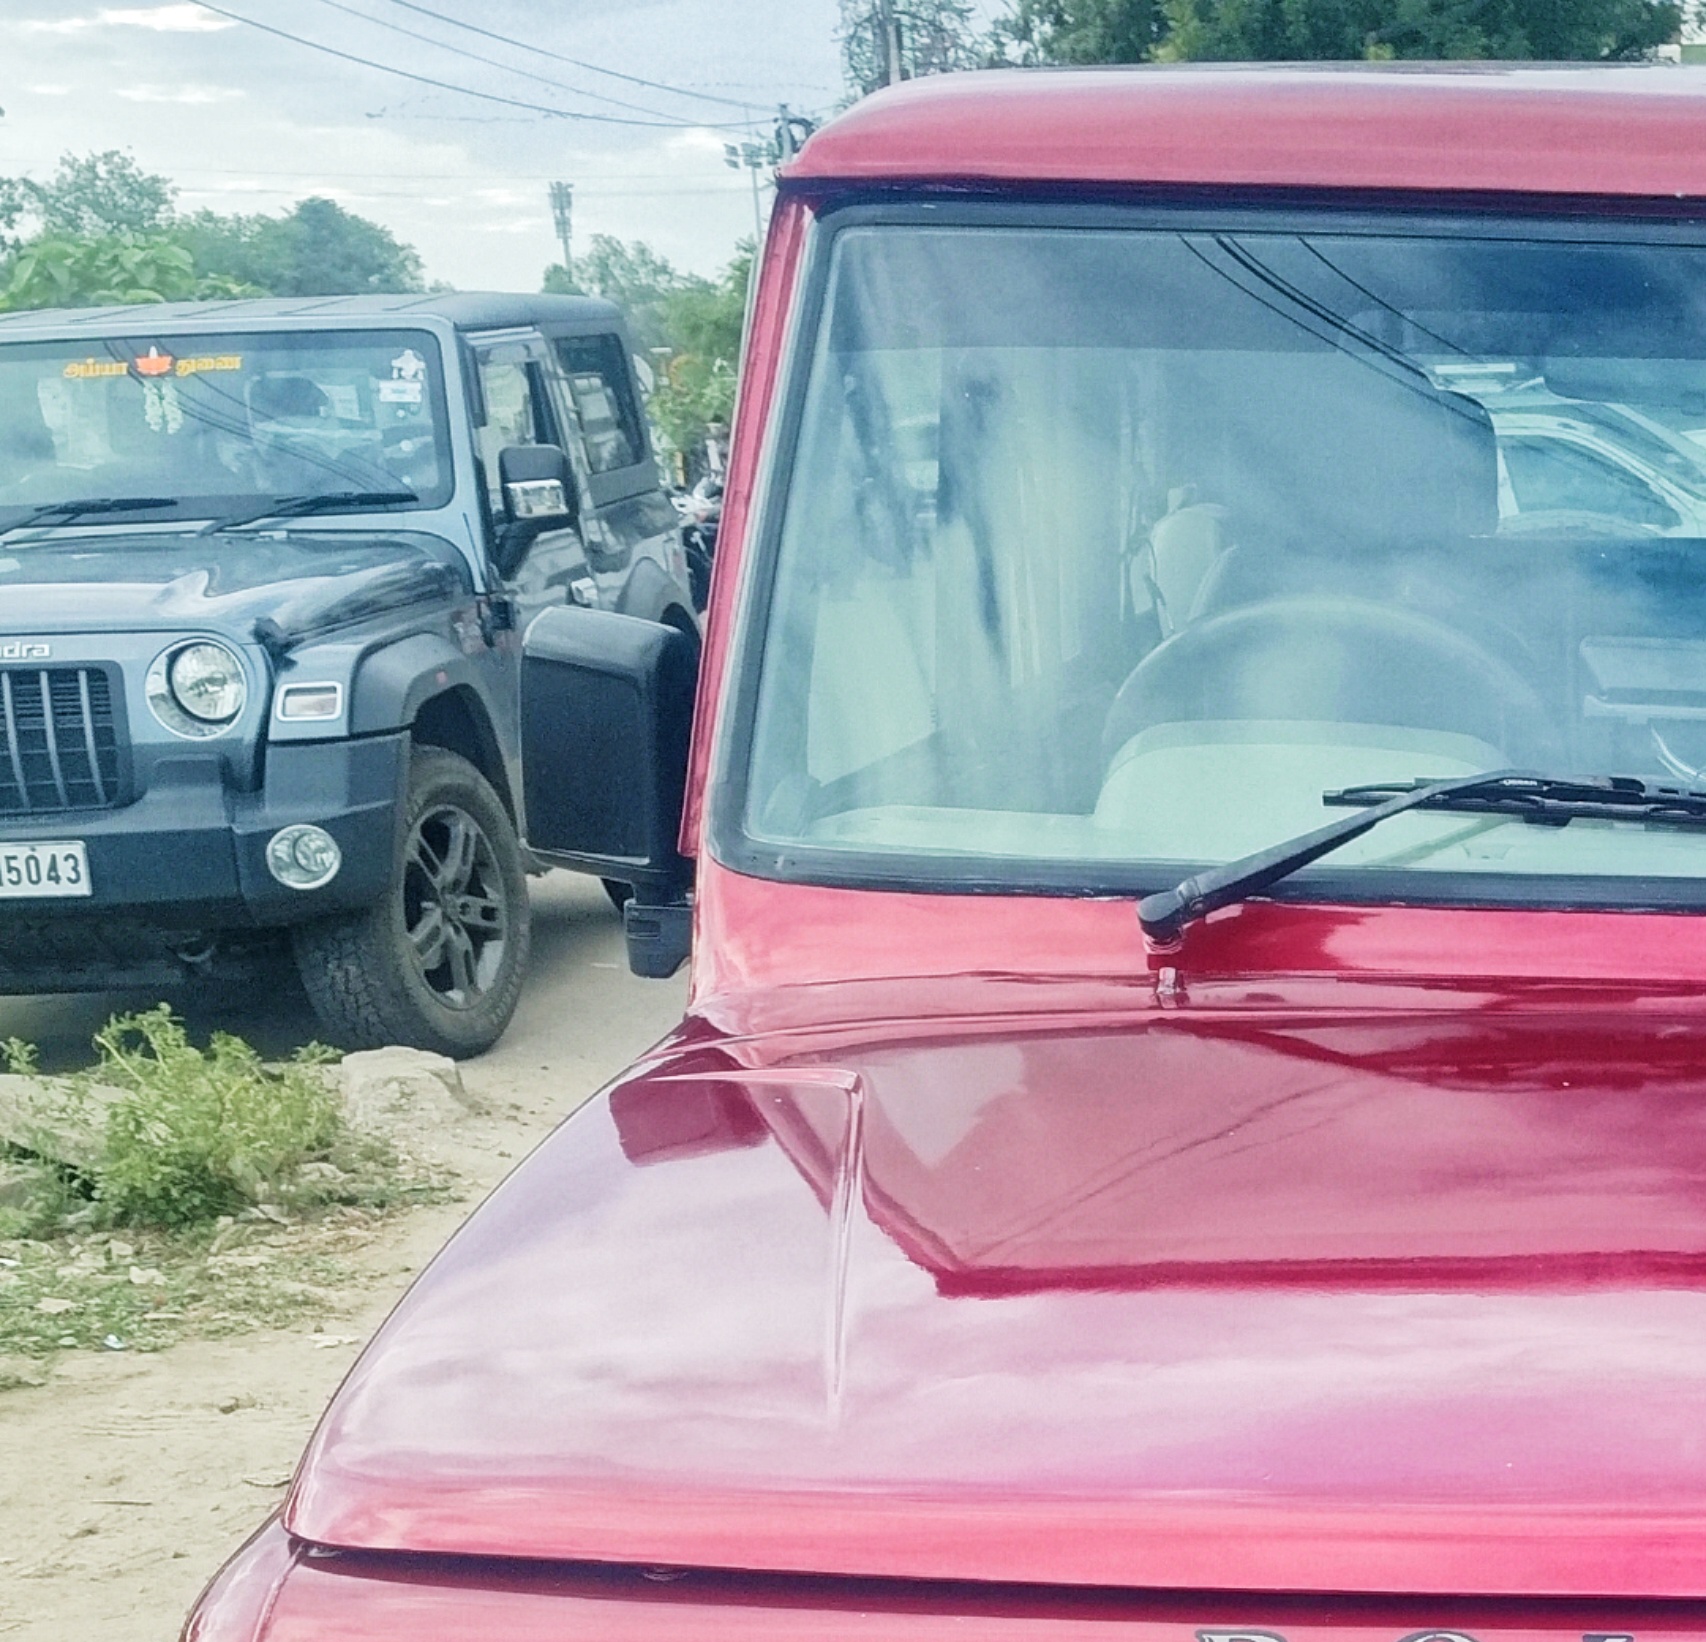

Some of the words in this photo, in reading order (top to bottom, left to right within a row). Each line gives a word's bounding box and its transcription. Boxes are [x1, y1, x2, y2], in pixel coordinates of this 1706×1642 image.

[175, 355, 242, 377] துணை
[0, 641, 50, 658] dra
[0, 852, 82, 886] 5043
